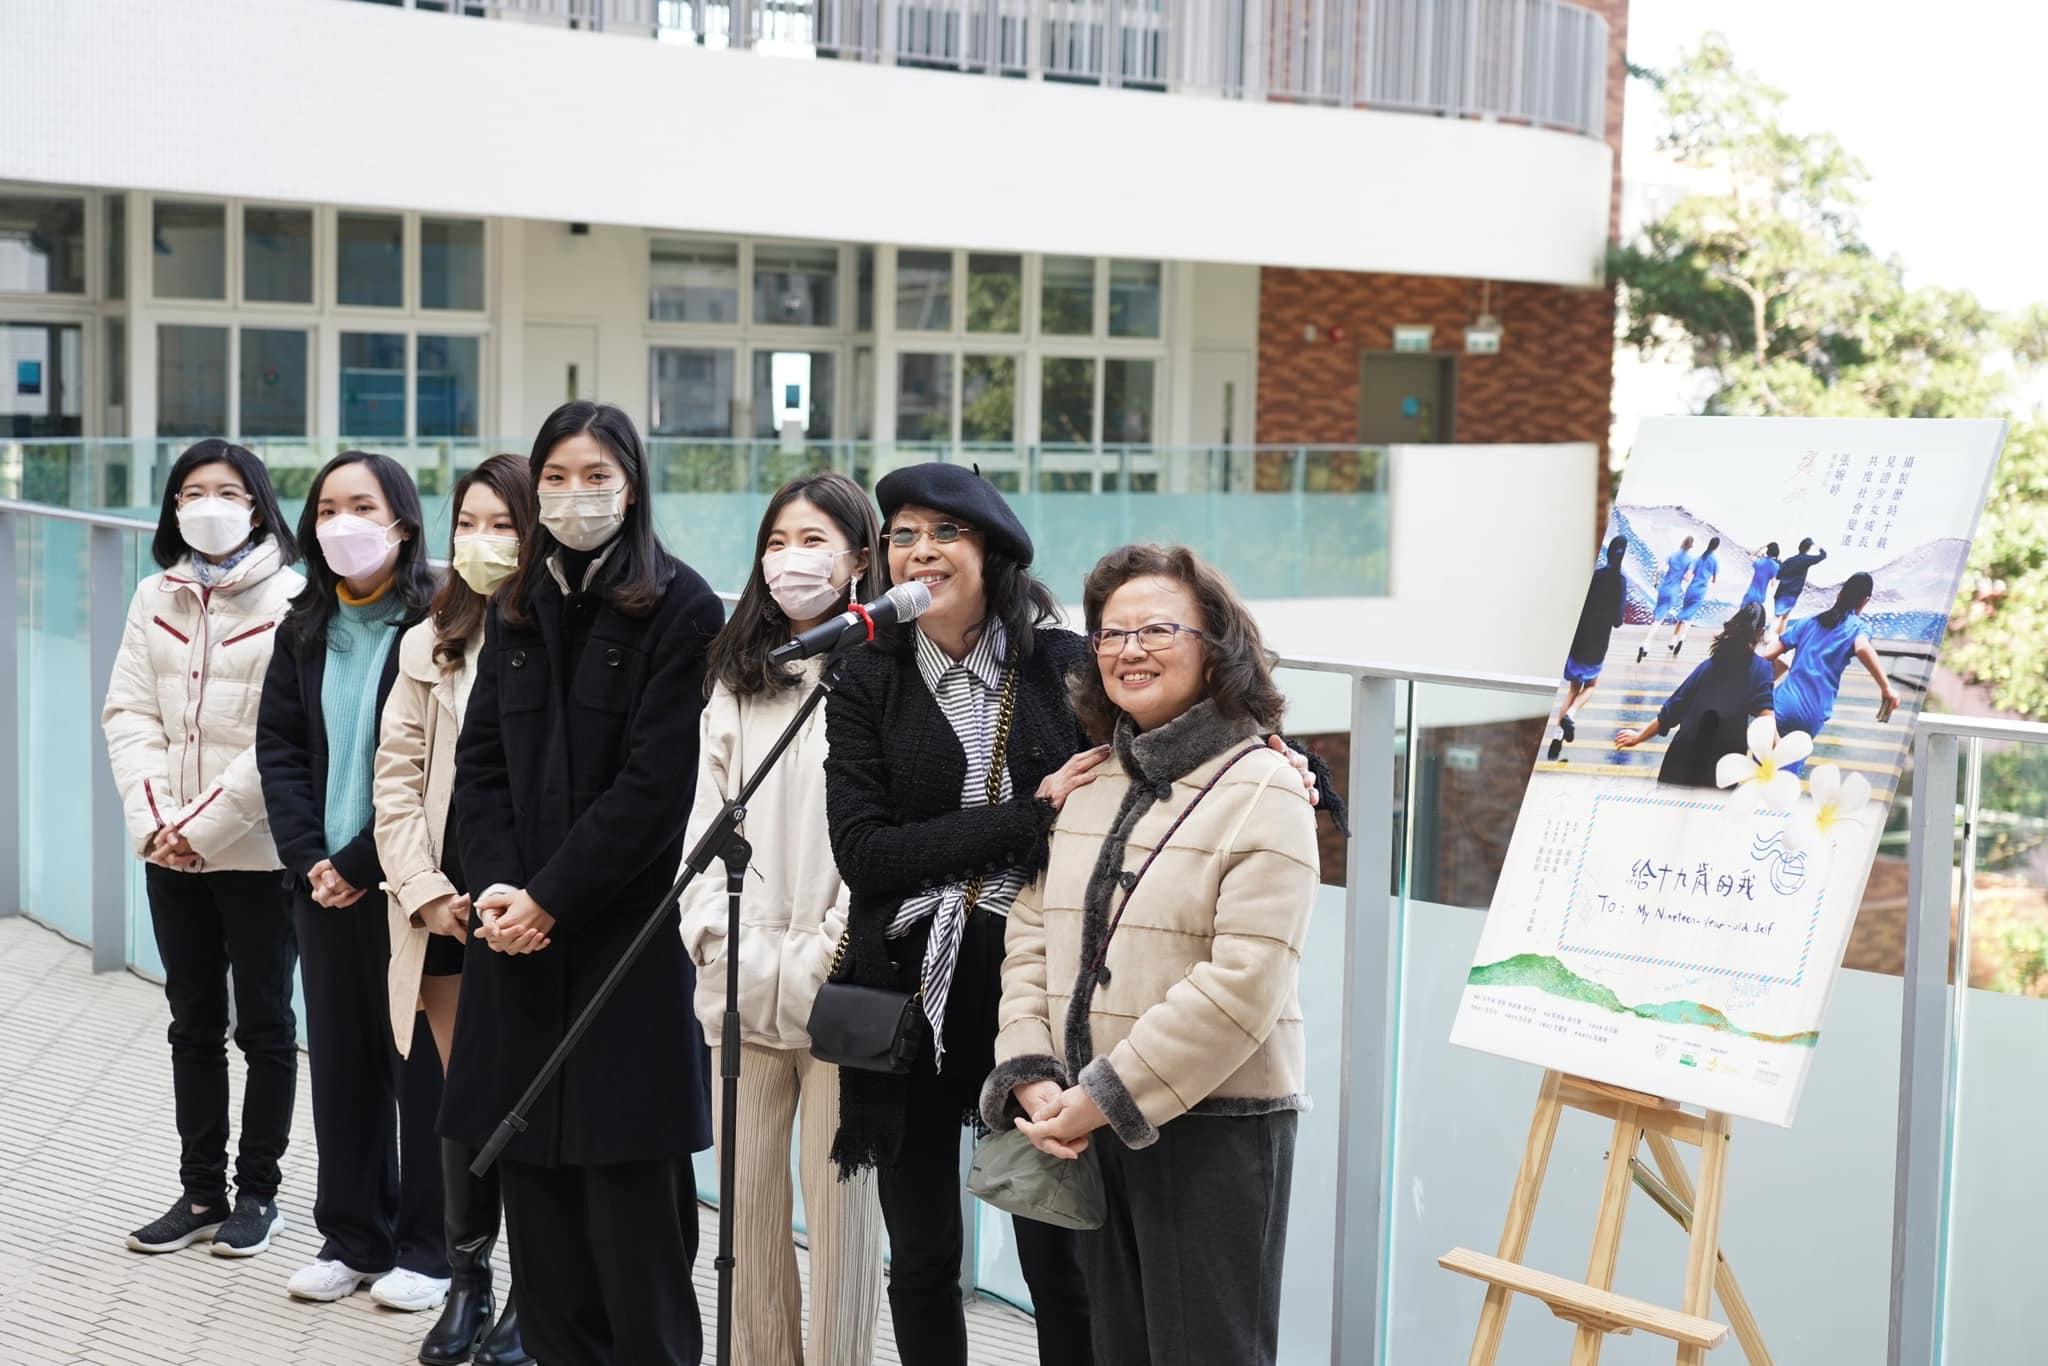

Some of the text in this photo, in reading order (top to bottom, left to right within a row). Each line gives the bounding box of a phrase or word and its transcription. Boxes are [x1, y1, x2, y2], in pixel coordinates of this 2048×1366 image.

[1858, 455, 1896, 548] 見證少女成長
[1626, 859, 1756, 901] 給十九歲的我
[1636, 904, 1650, 926] My
